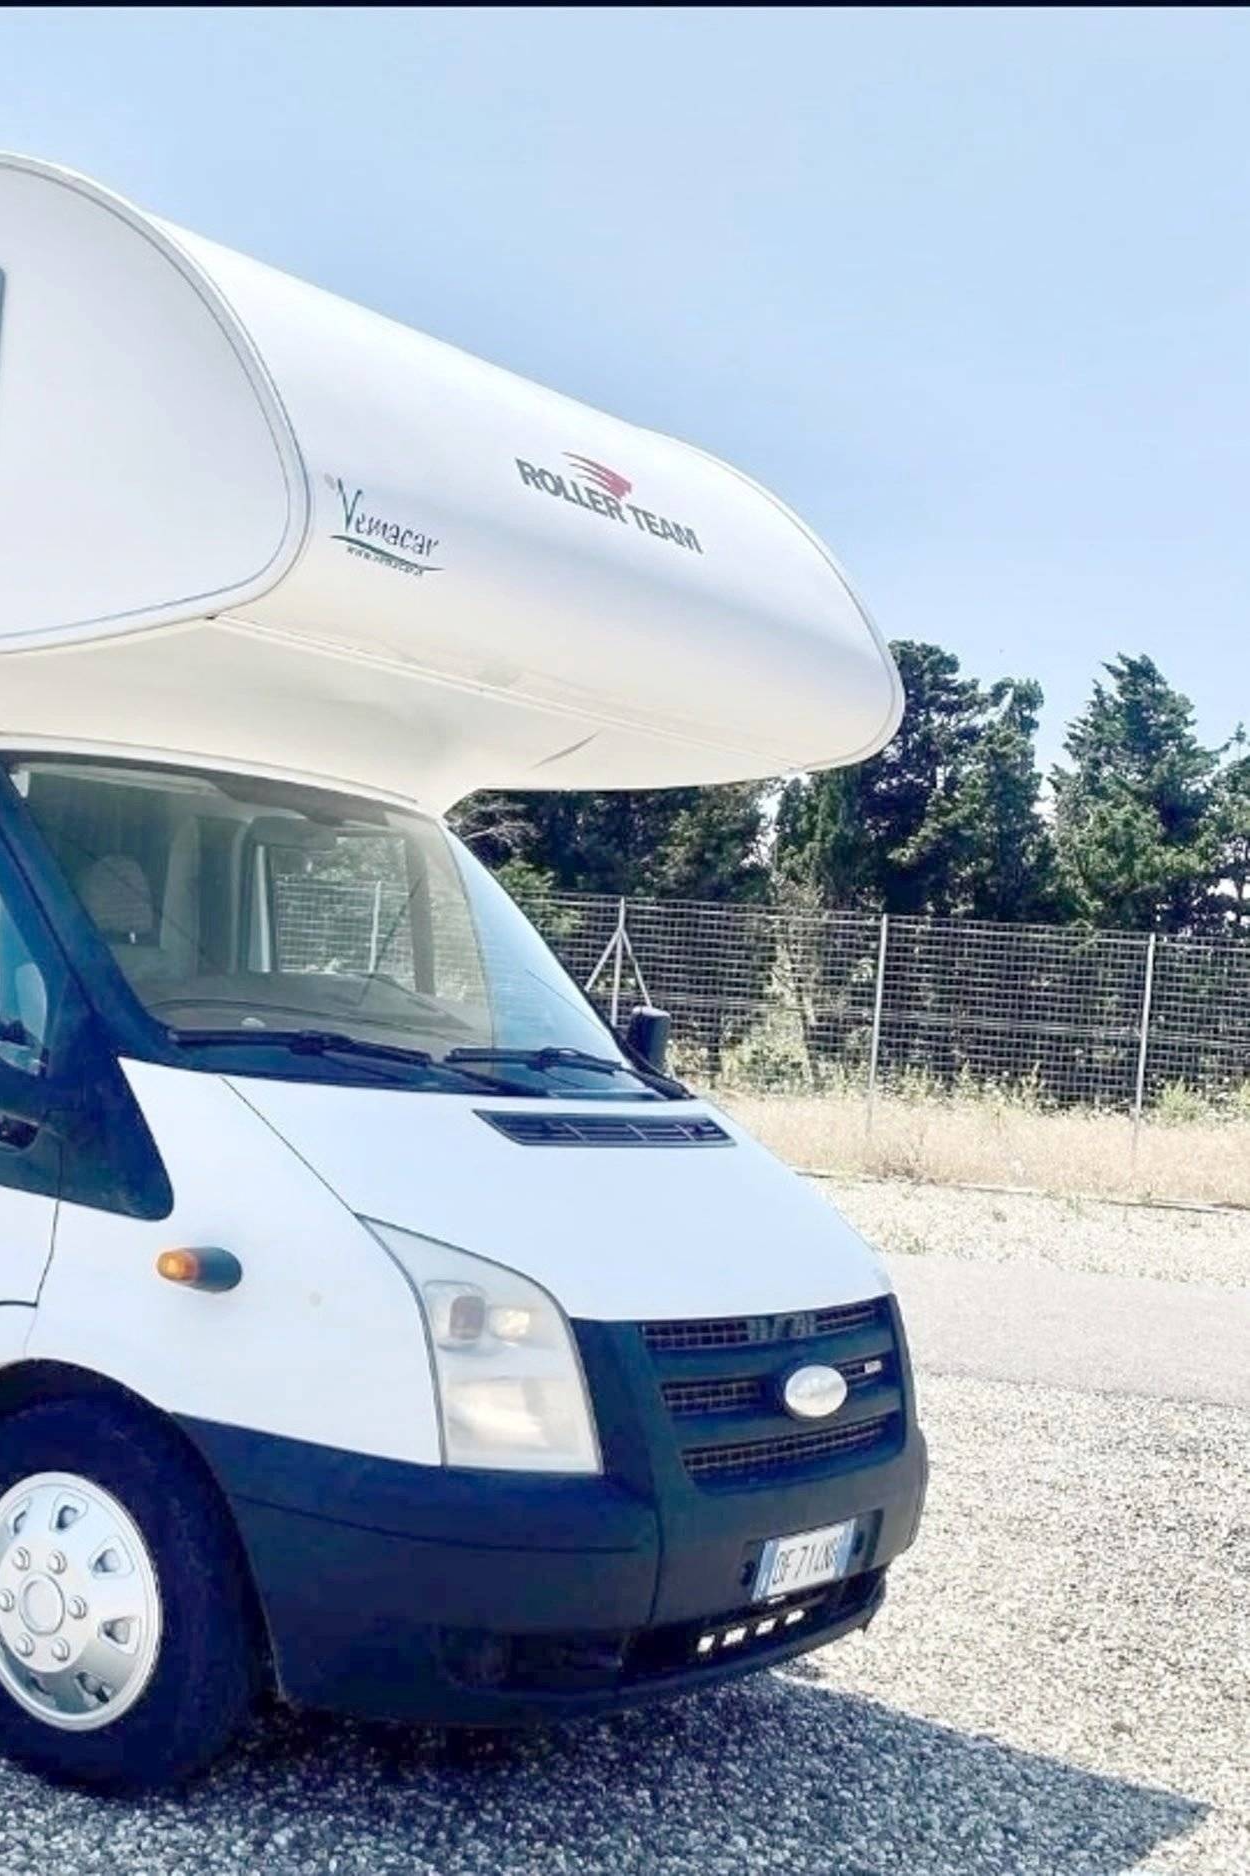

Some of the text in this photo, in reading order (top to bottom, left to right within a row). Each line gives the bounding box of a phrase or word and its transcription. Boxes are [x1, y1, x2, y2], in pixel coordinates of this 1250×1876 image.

[337, 478, 439, 557] Vemacar
[515, 457, 703, 554] ROLLER TEAM
